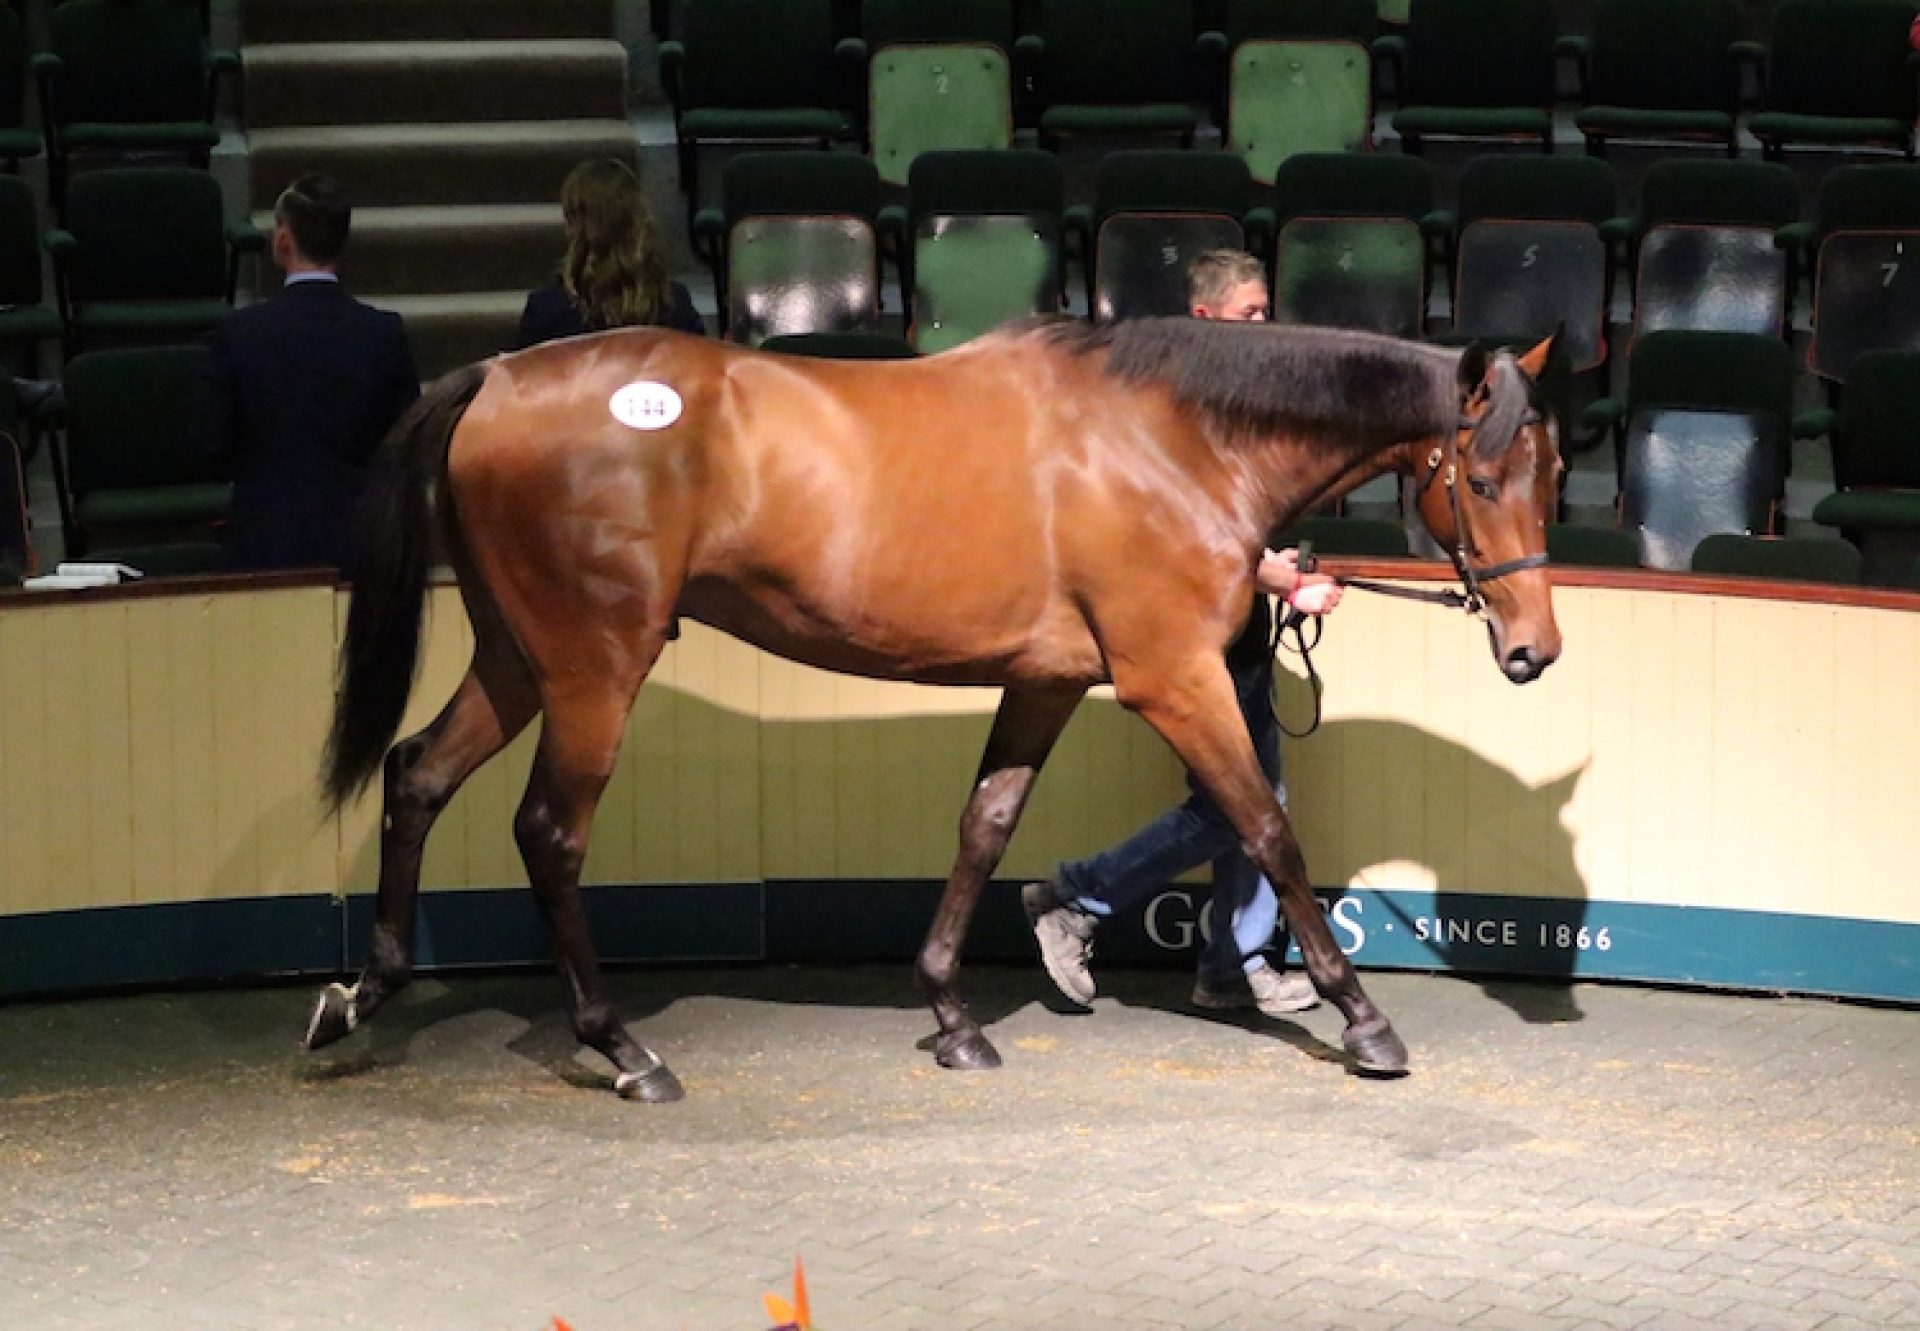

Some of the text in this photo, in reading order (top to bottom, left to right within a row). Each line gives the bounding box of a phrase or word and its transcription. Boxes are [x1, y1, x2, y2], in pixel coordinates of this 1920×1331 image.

[1880, 262, 1900, 288] 7
[1414, 916, 1517, 946] SINCE
[1540, 923, 1612, 951] 1866
